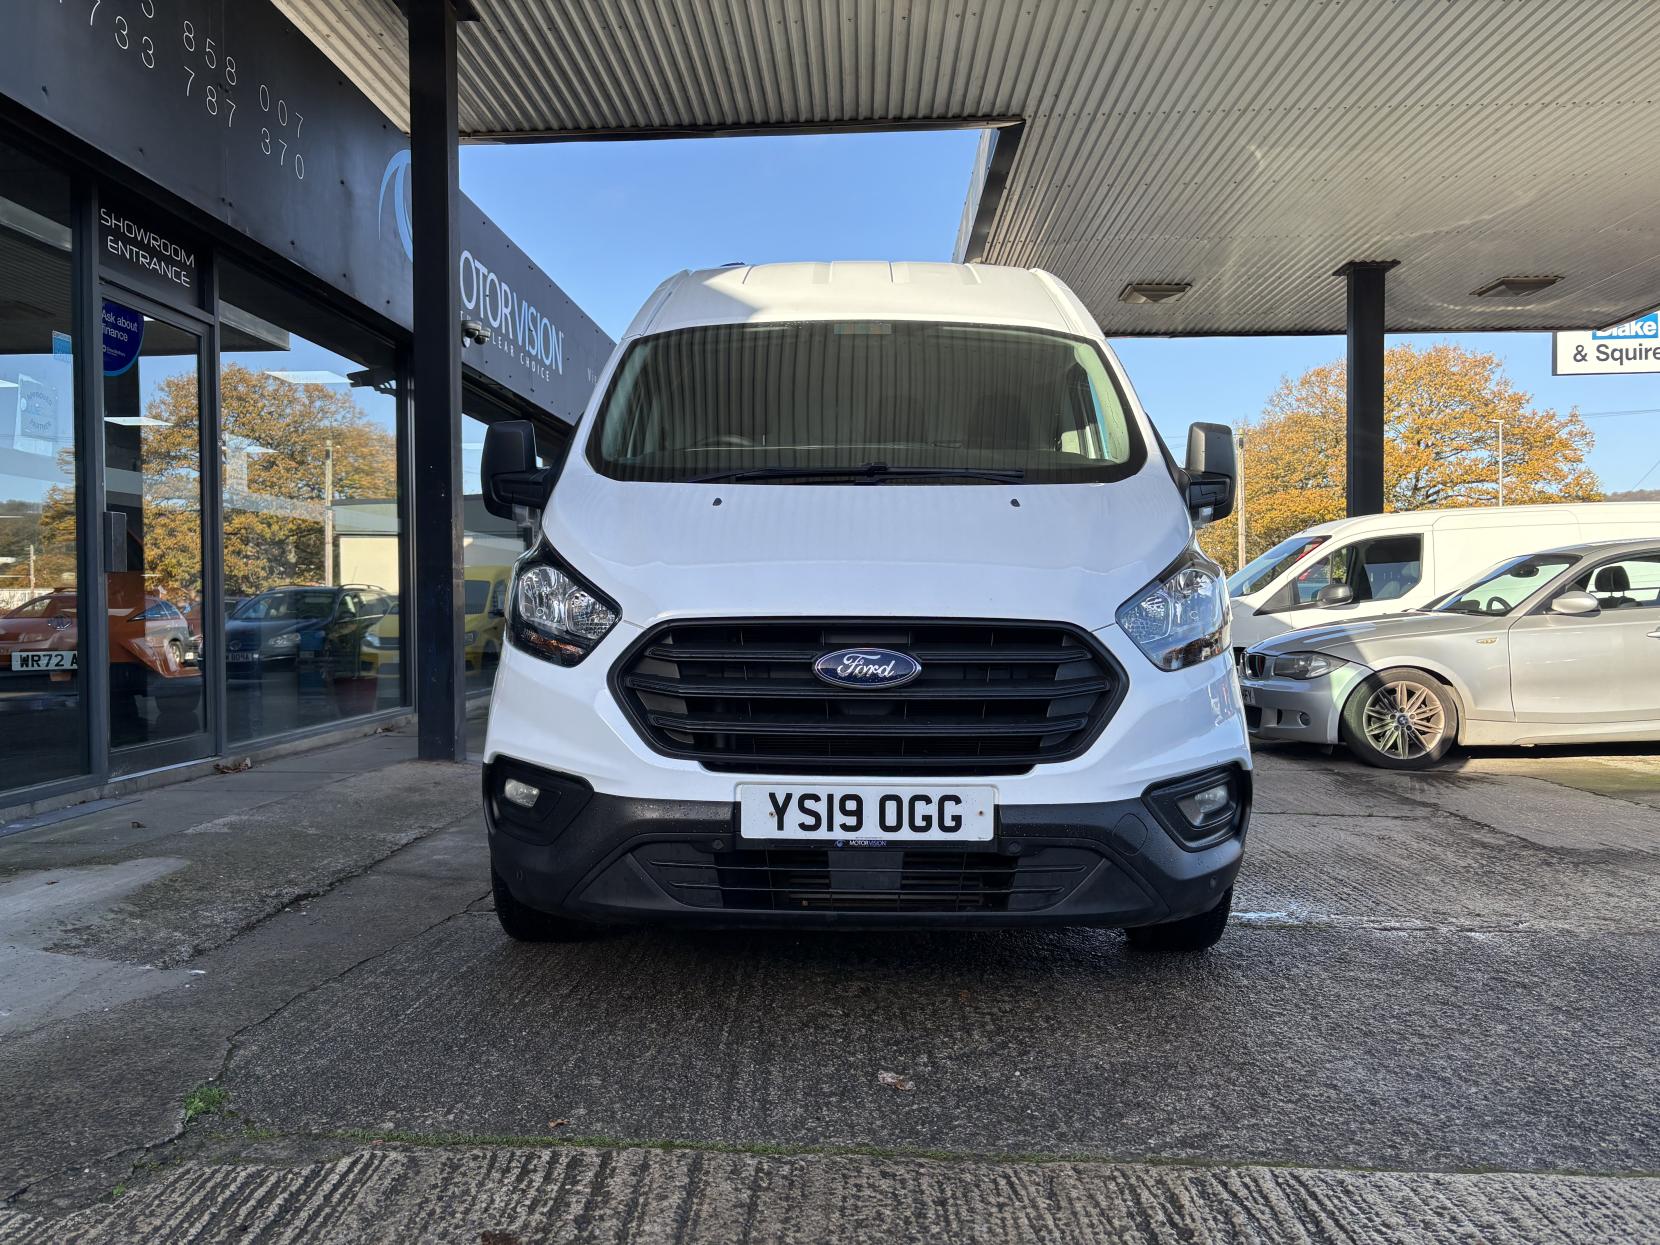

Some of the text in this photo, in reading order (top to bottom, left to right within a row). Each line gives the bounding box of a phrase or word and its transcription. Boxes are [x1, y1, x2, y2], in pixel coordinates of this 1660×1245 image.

[183, 20, 237, 86] 858
[259, 84, 304, 138] 007
[184, 66, 236, 127] 787
[261, 127, 304, 180] 370
[100, 208, 195, 268] SHOWROOM
[107, 236, 191, 288] ENTRANCE
[102, 309, 138, 332] Ask about
[459, 250, 563, 375] OTORVISION
[487, 332, 551, 382] LEAR CHOICE
[1573, 344, 1588, 362] &
[20, 653, 65, 668] WR72
[837, 653, 896, 678] Ford
[768, 792, 963, 833] YS19 OGG
